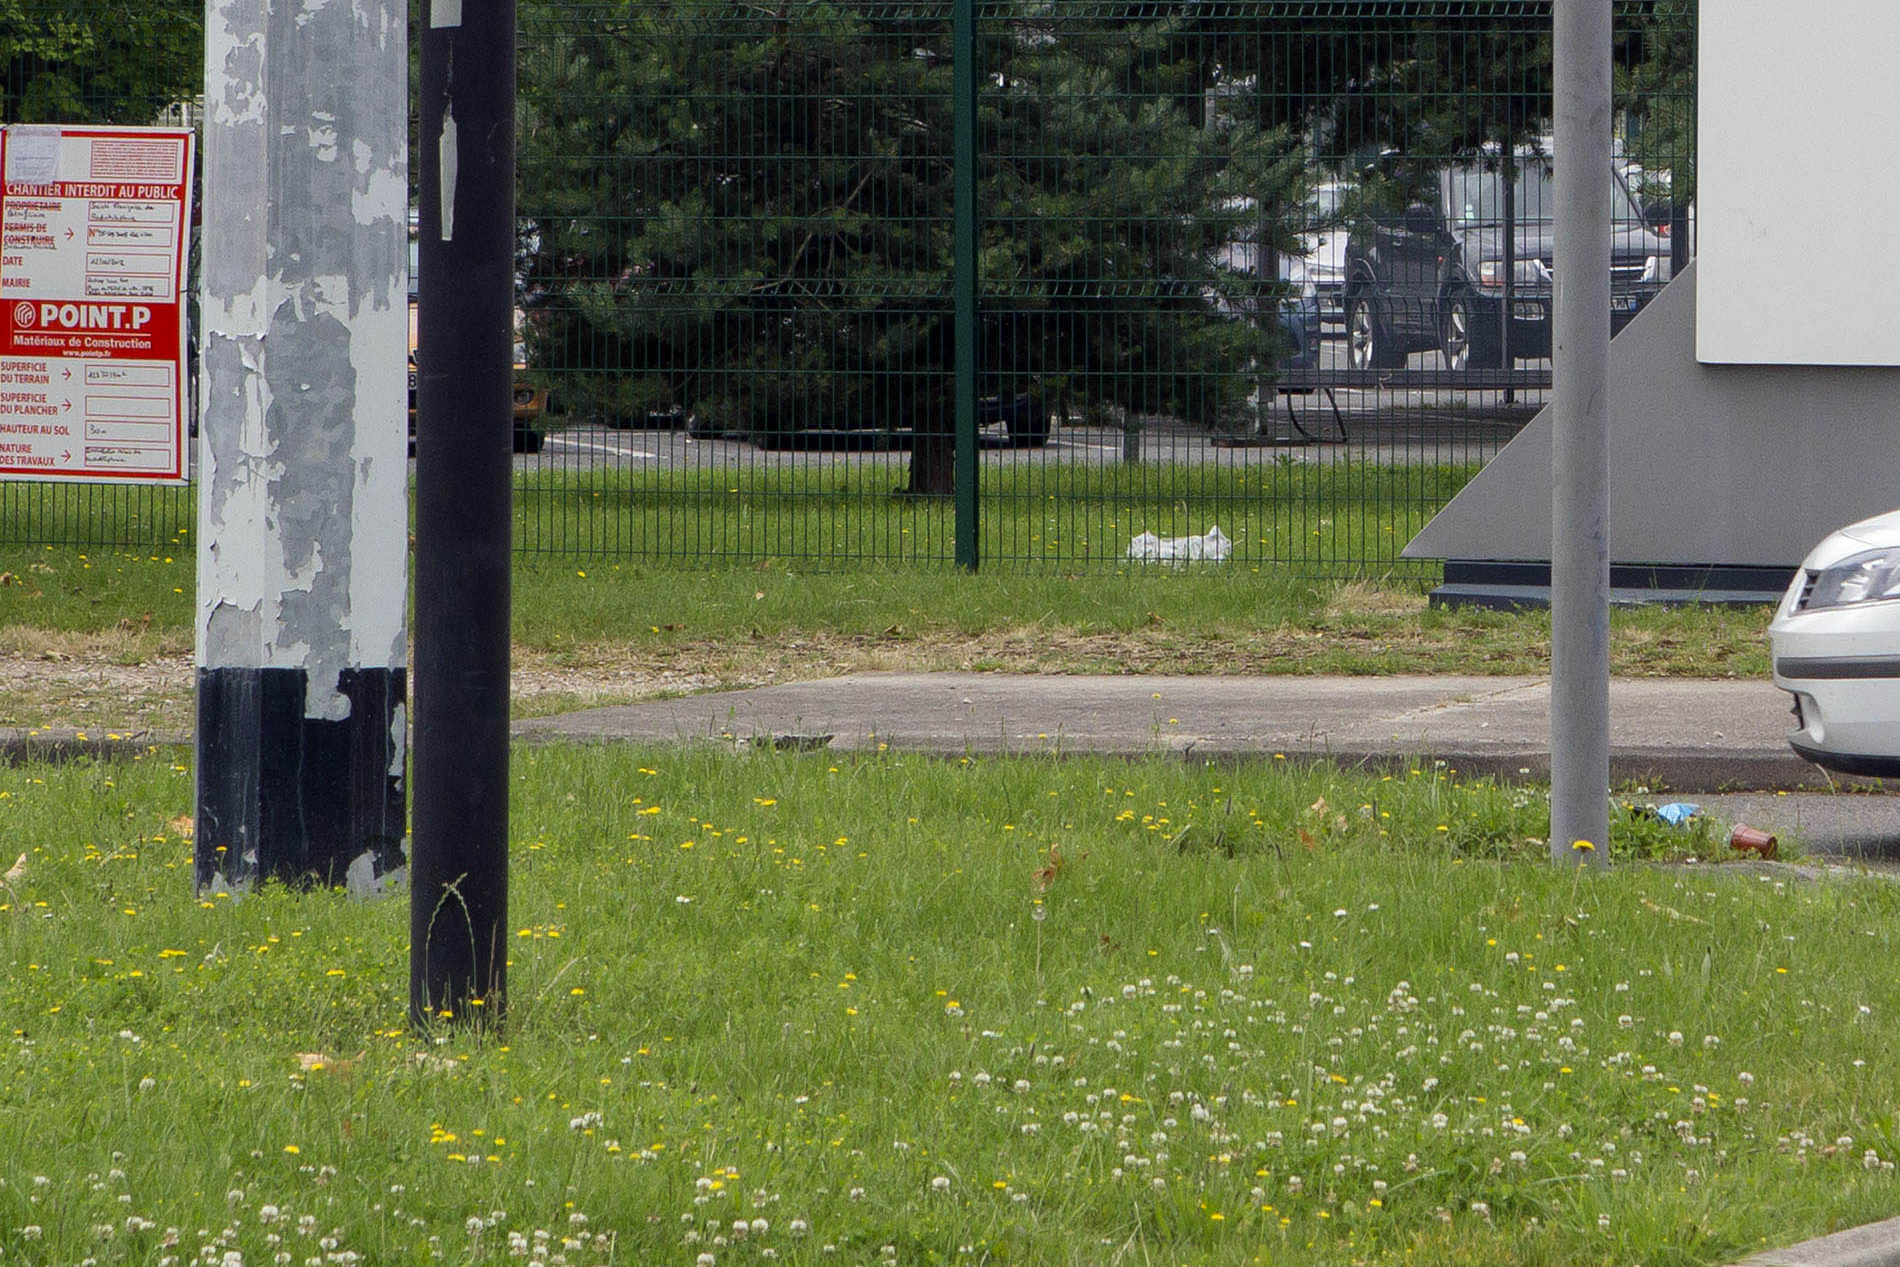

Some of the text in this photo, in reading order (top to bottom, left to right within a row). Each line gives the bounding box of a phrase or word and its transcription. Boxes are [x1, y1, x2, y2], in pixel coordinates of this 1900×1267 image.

[6, 184, 179, 199] CHANTIER INTERDIT AU PUBLIC
[2, 256, 24, 266] DATE
[2, 277, 31, 288] MAIRIE
[40, 303, 152, 330] POINT.P
[13, 335, 152, 349] Matériaux de Construction
[1, 361, 48, 372] SUPERFICIE
[1, 373, 50, 384] DU TERRAIN
[1, 393, 47, 403] SUPERFICIE
[1, 404, 58, 416] DU PLANCHER
[0, 423, 70, 436] HAUTEUR AU SOL
[0, 443, 32, 454] NATURE
[0, 455, 56, 467] DES TRAVAUX
